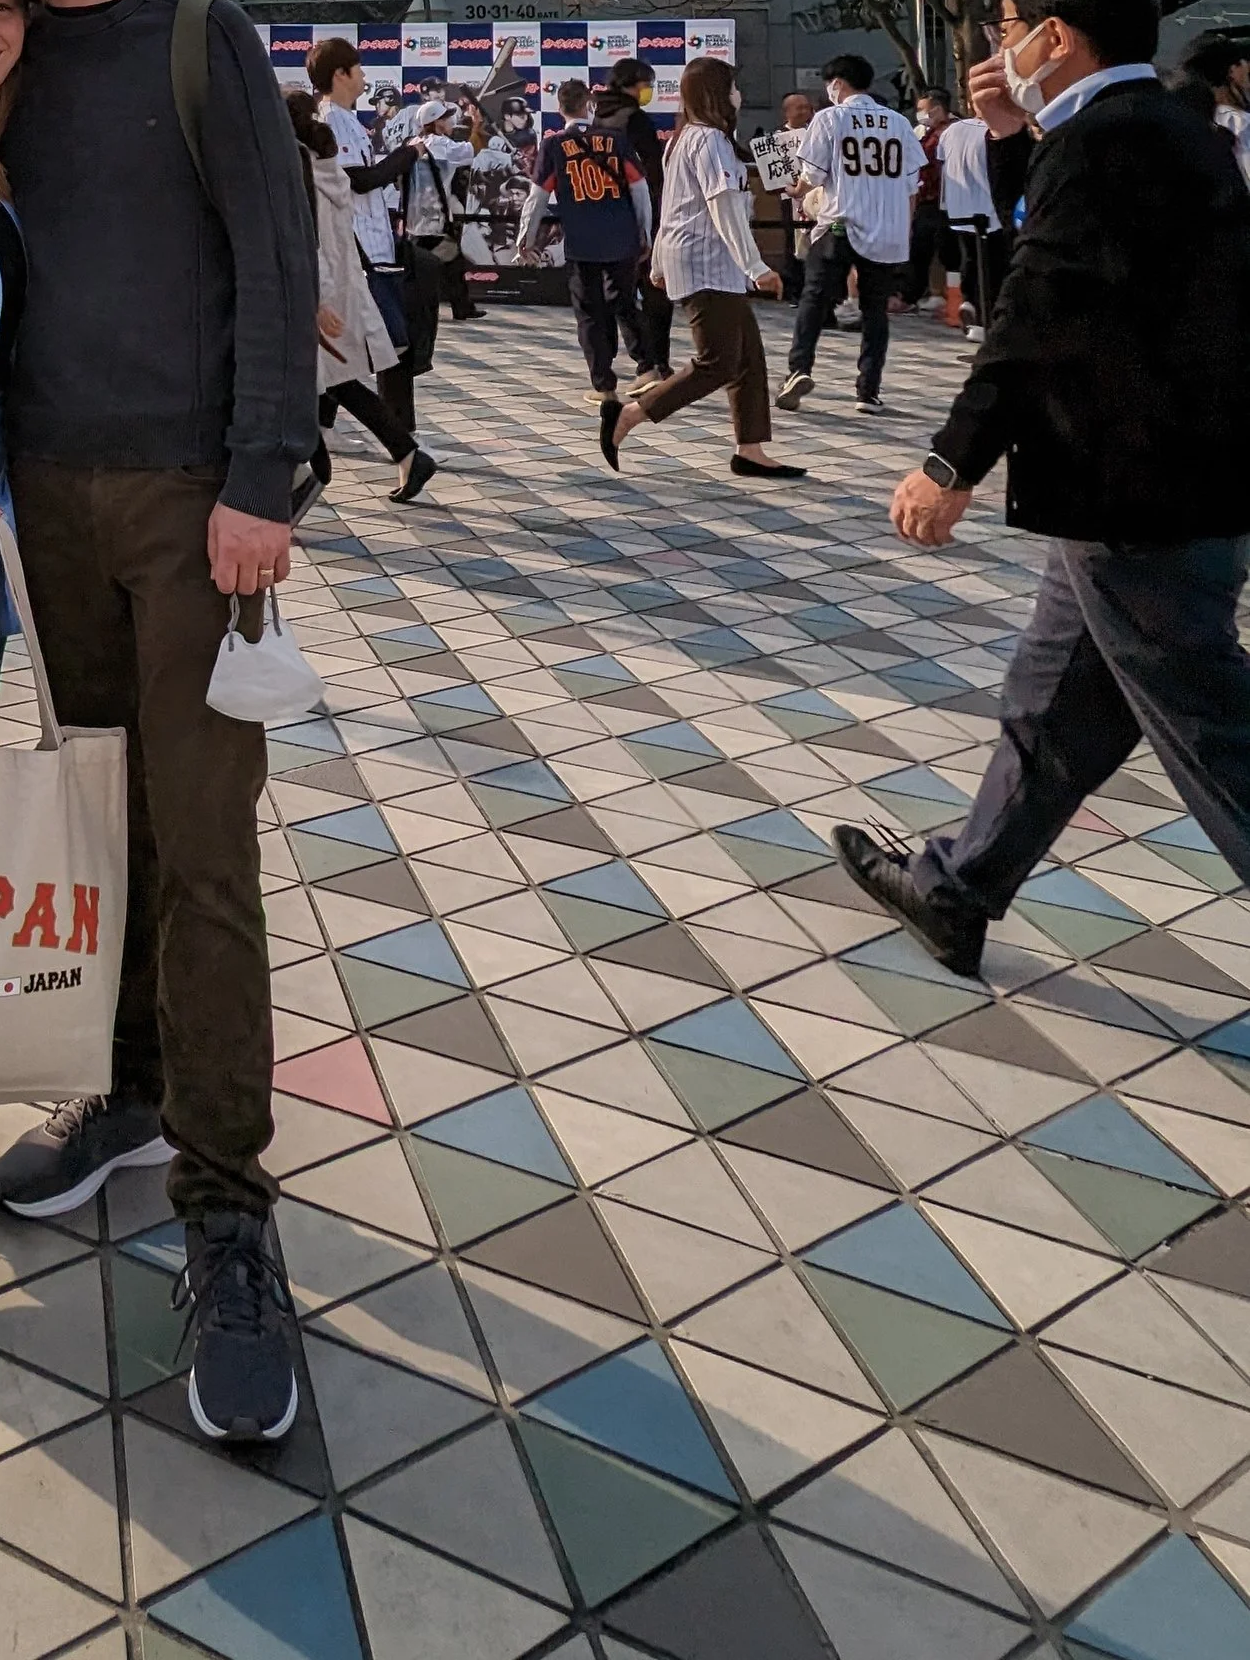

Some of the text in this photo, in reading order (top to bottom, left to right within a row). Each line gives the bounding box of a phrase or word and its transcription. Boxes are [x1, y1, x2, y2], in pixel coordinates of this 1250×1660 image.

[537, 11, 559, 19] GATE
[852, 114, 888, 130] ABE
[561, 135, 614, 157] MKI
[841, 136, 903, 179] 930
[566, 156, 621, 202] 104
[23, 966, 82, 993] JAPAN
